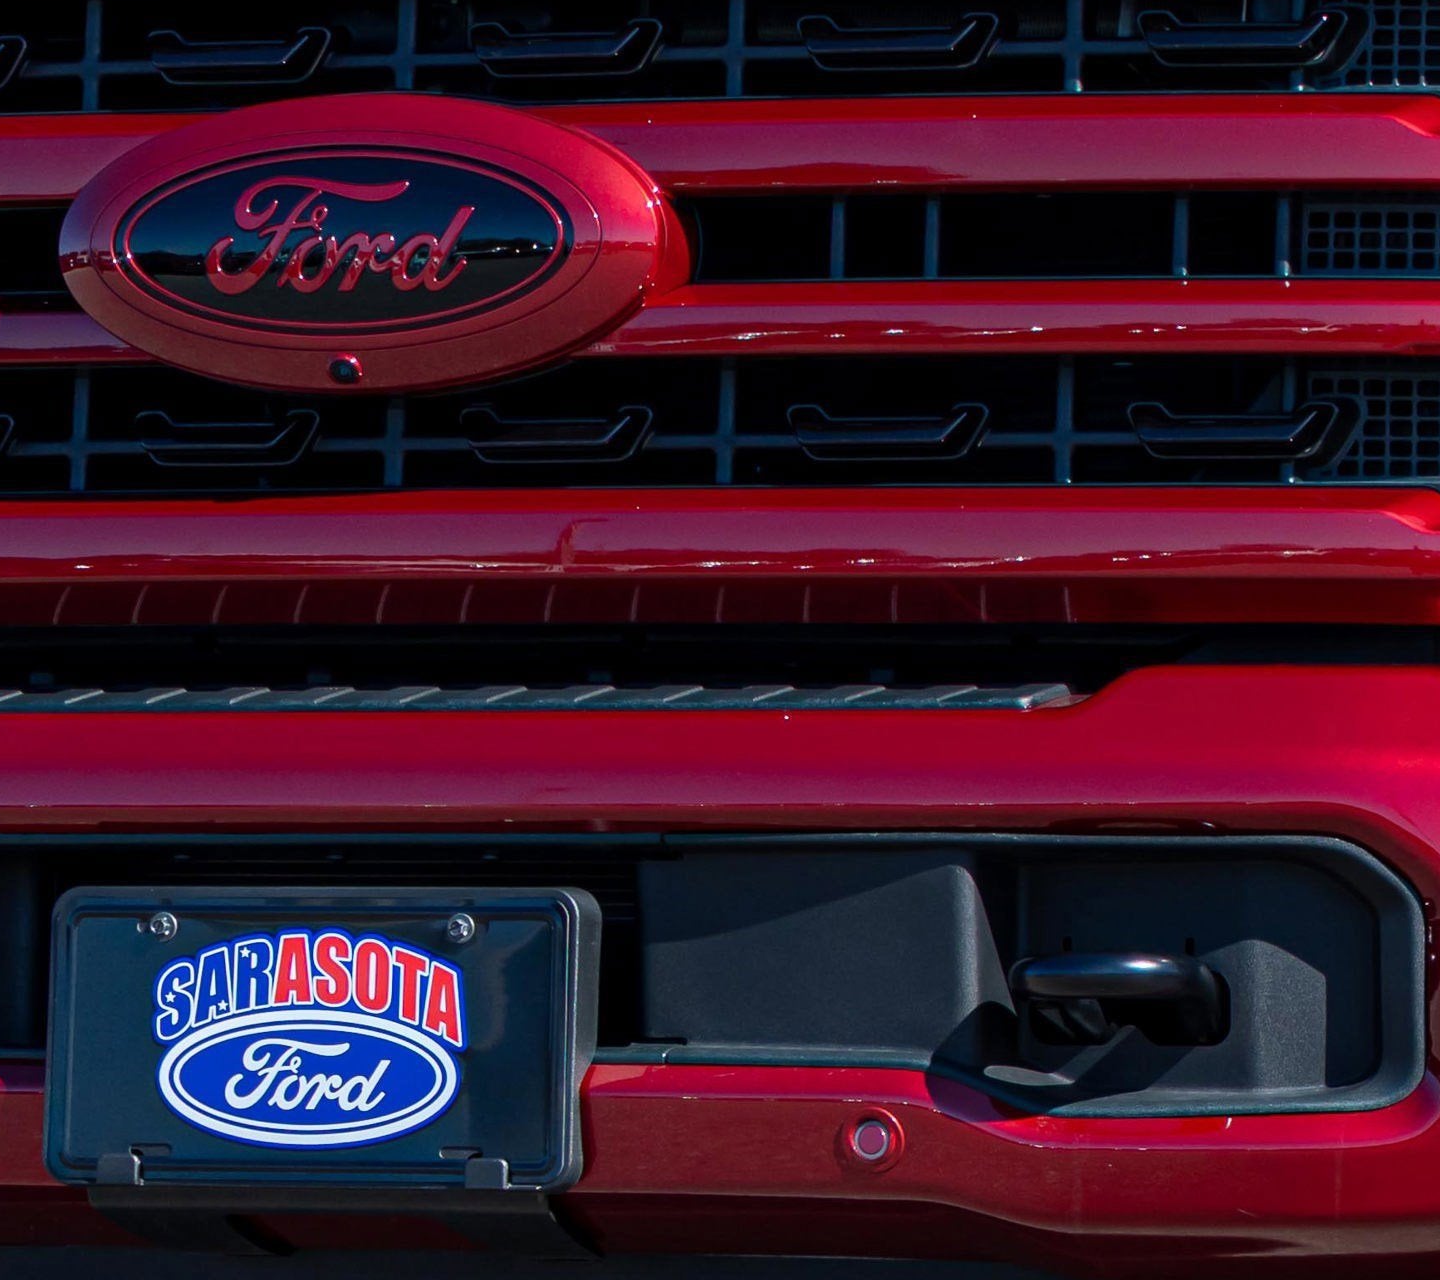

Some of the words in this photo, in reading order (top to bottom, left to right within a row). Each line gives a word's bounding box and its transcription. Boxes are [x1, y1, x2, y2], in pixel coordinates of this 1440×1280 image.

[205, 175, 475, 296] Ford
[157, 932, 464, 1048] SARASOTA
[224, 1037, 392, 1113] Ford
